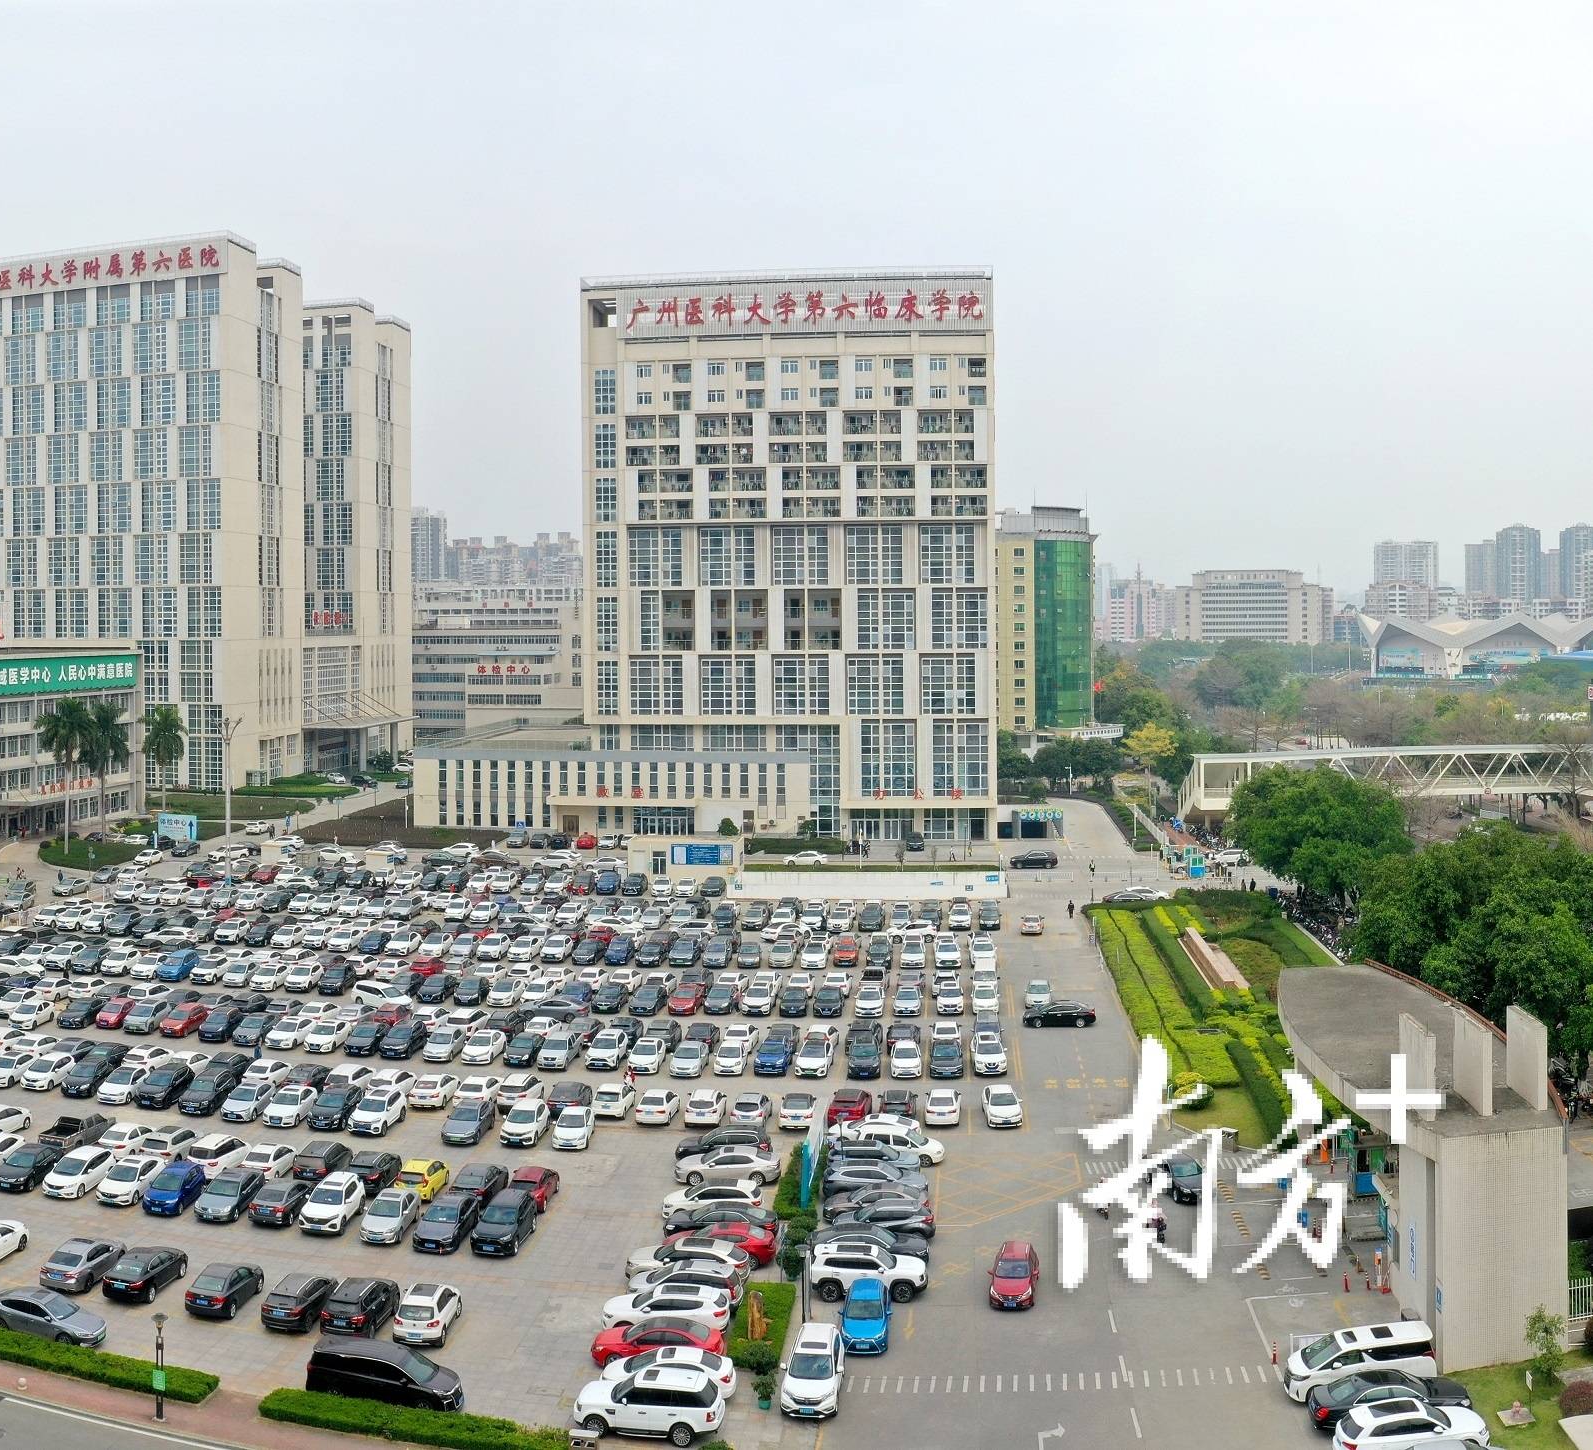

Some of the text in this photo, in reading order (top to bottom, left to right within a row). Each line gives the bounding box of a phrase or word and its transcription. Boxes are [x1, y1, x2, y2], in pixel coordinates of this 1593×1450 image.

[625, 289, 984, 331] 广州医科大学第六临床学院
[57, 662, 133, 682] 人民心中满意医院
[477, 665, 530, 675] 体检中心
